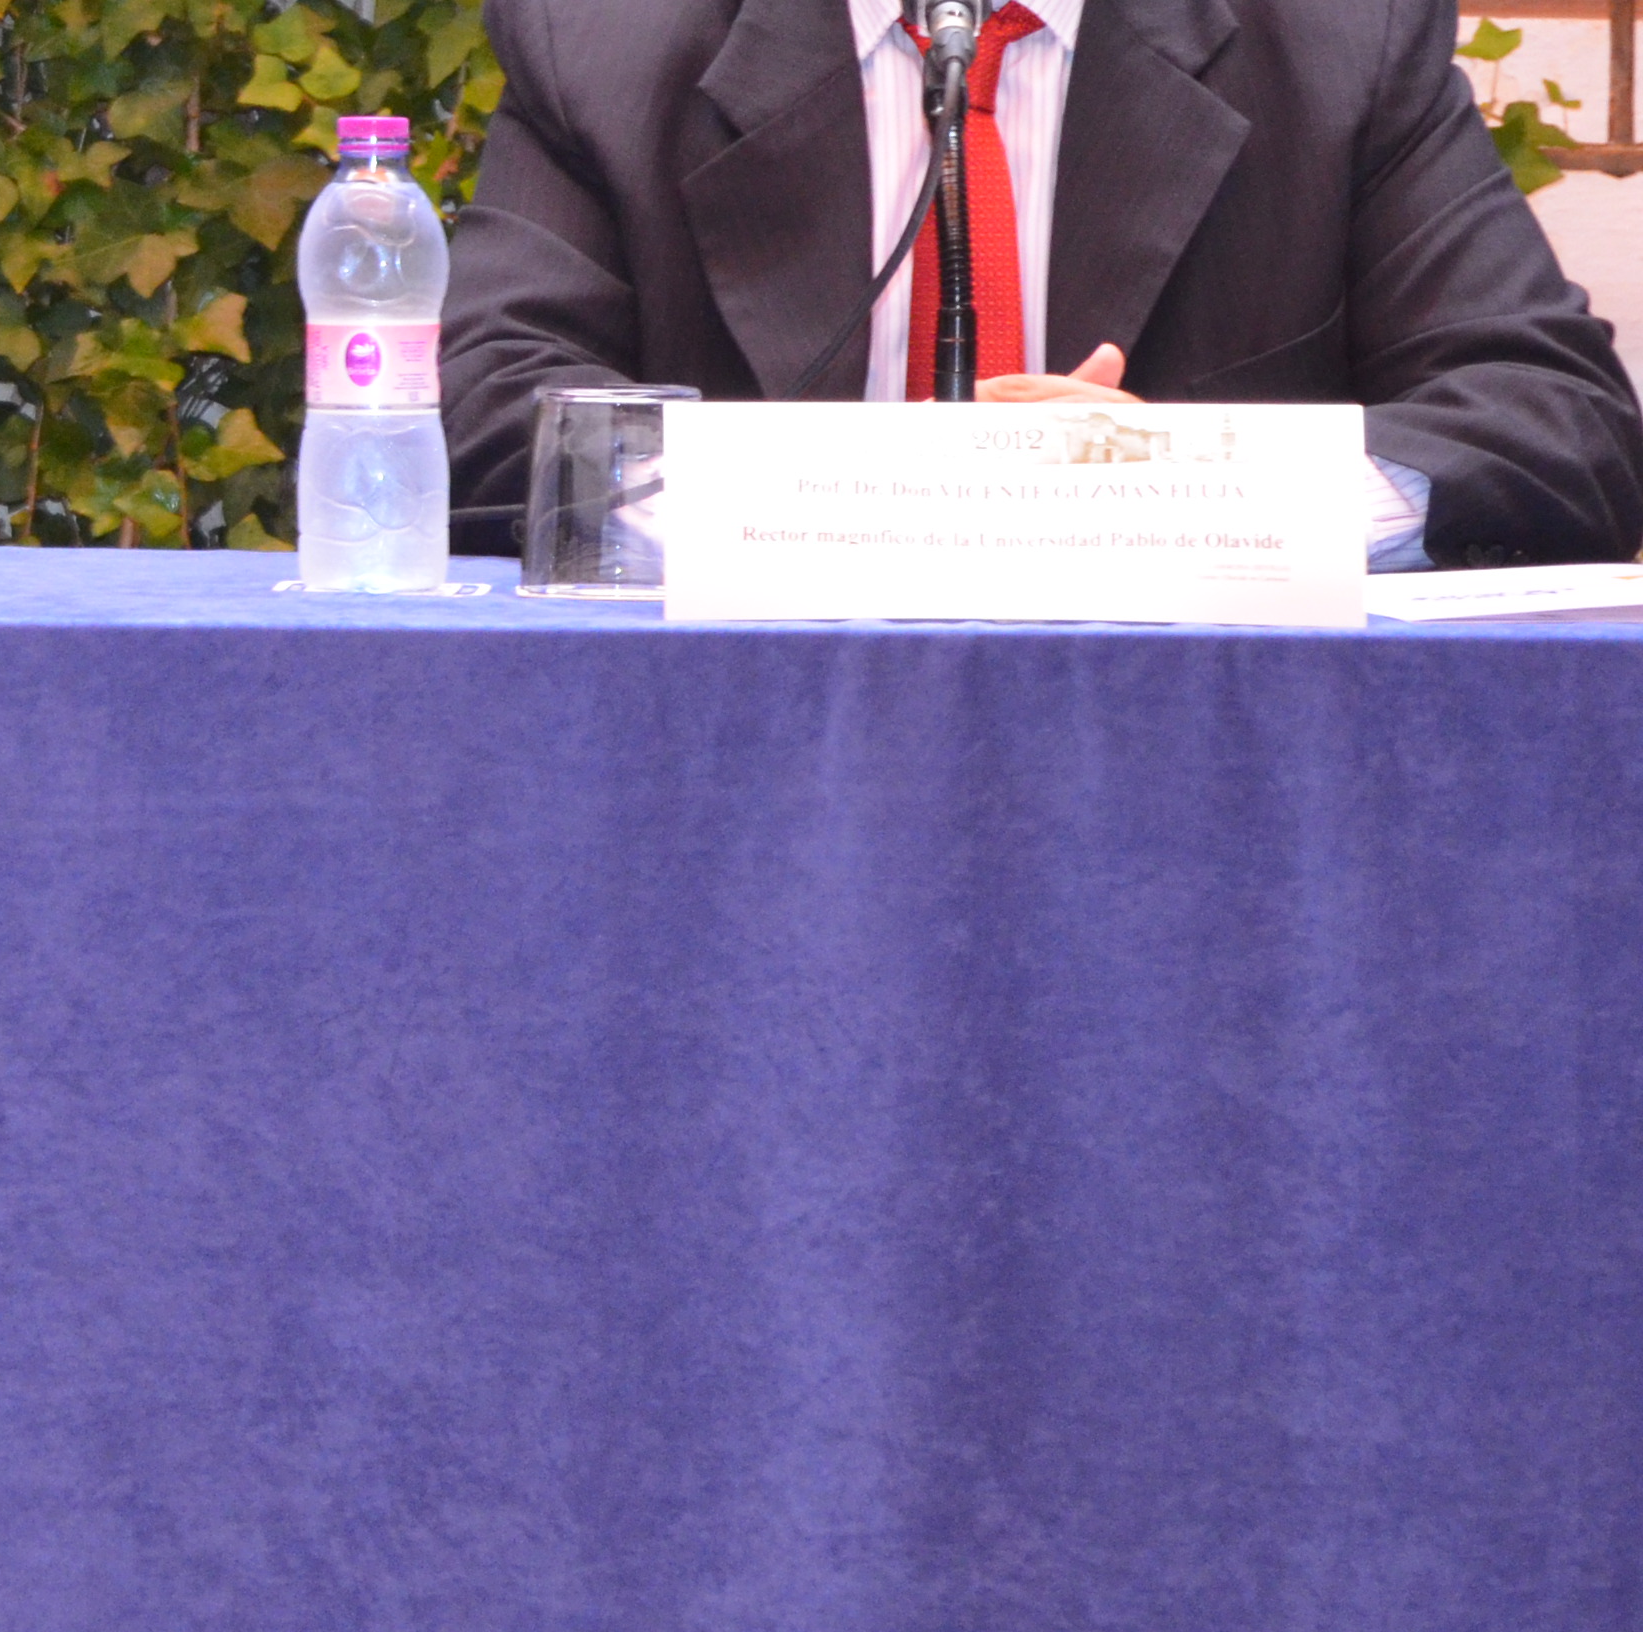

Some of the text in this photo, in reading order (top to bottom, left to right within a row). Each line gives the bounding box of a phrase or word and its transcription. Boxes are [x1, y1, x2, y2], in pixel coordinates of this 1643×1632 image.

[971, 428, 1046, 451] 2012
[892, 481, 932, 497] Don
[939, 483, 1042, 499] VICENTE
[742, 525, 809, 543] Rector
[923, 531, 946, 547] de
[953, 531, 971, 548] la
[978, 531, 1102, 548] Universidad
[1110, 532, 1168, 549] Pablo
[1174, 532, 1198, 549] de
[1203, 532, 1286, 550] Olavide
